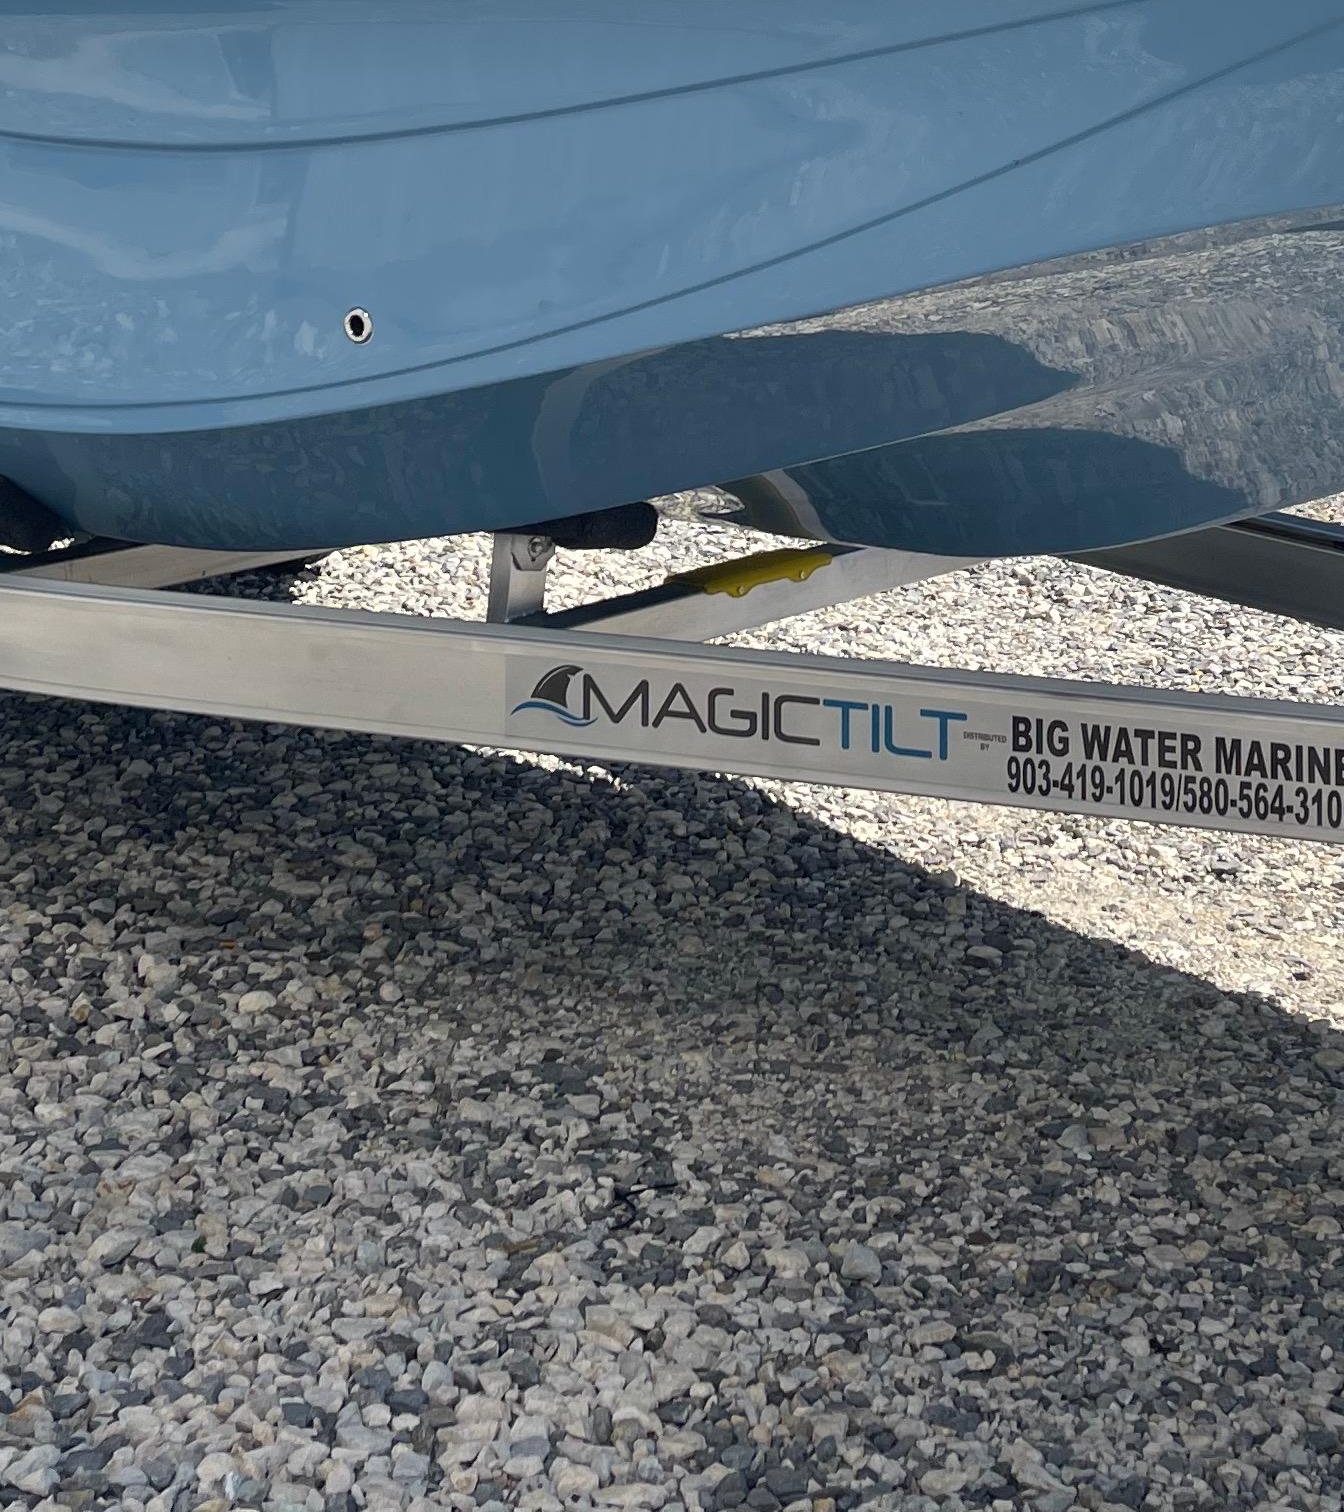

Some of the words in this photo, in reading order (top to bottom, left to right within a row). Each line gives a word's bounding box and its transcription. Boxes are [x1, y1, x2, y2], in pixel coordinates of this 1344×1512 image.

[582, 673, 968, 761] MAGICTILT
[963, 730, 1007, 744] DISTRIBUTED
[979, 742, 991, 751] BY
[1011, 715, 1070, 757] BIG
[1080, 723, 1203, 772] WATER
